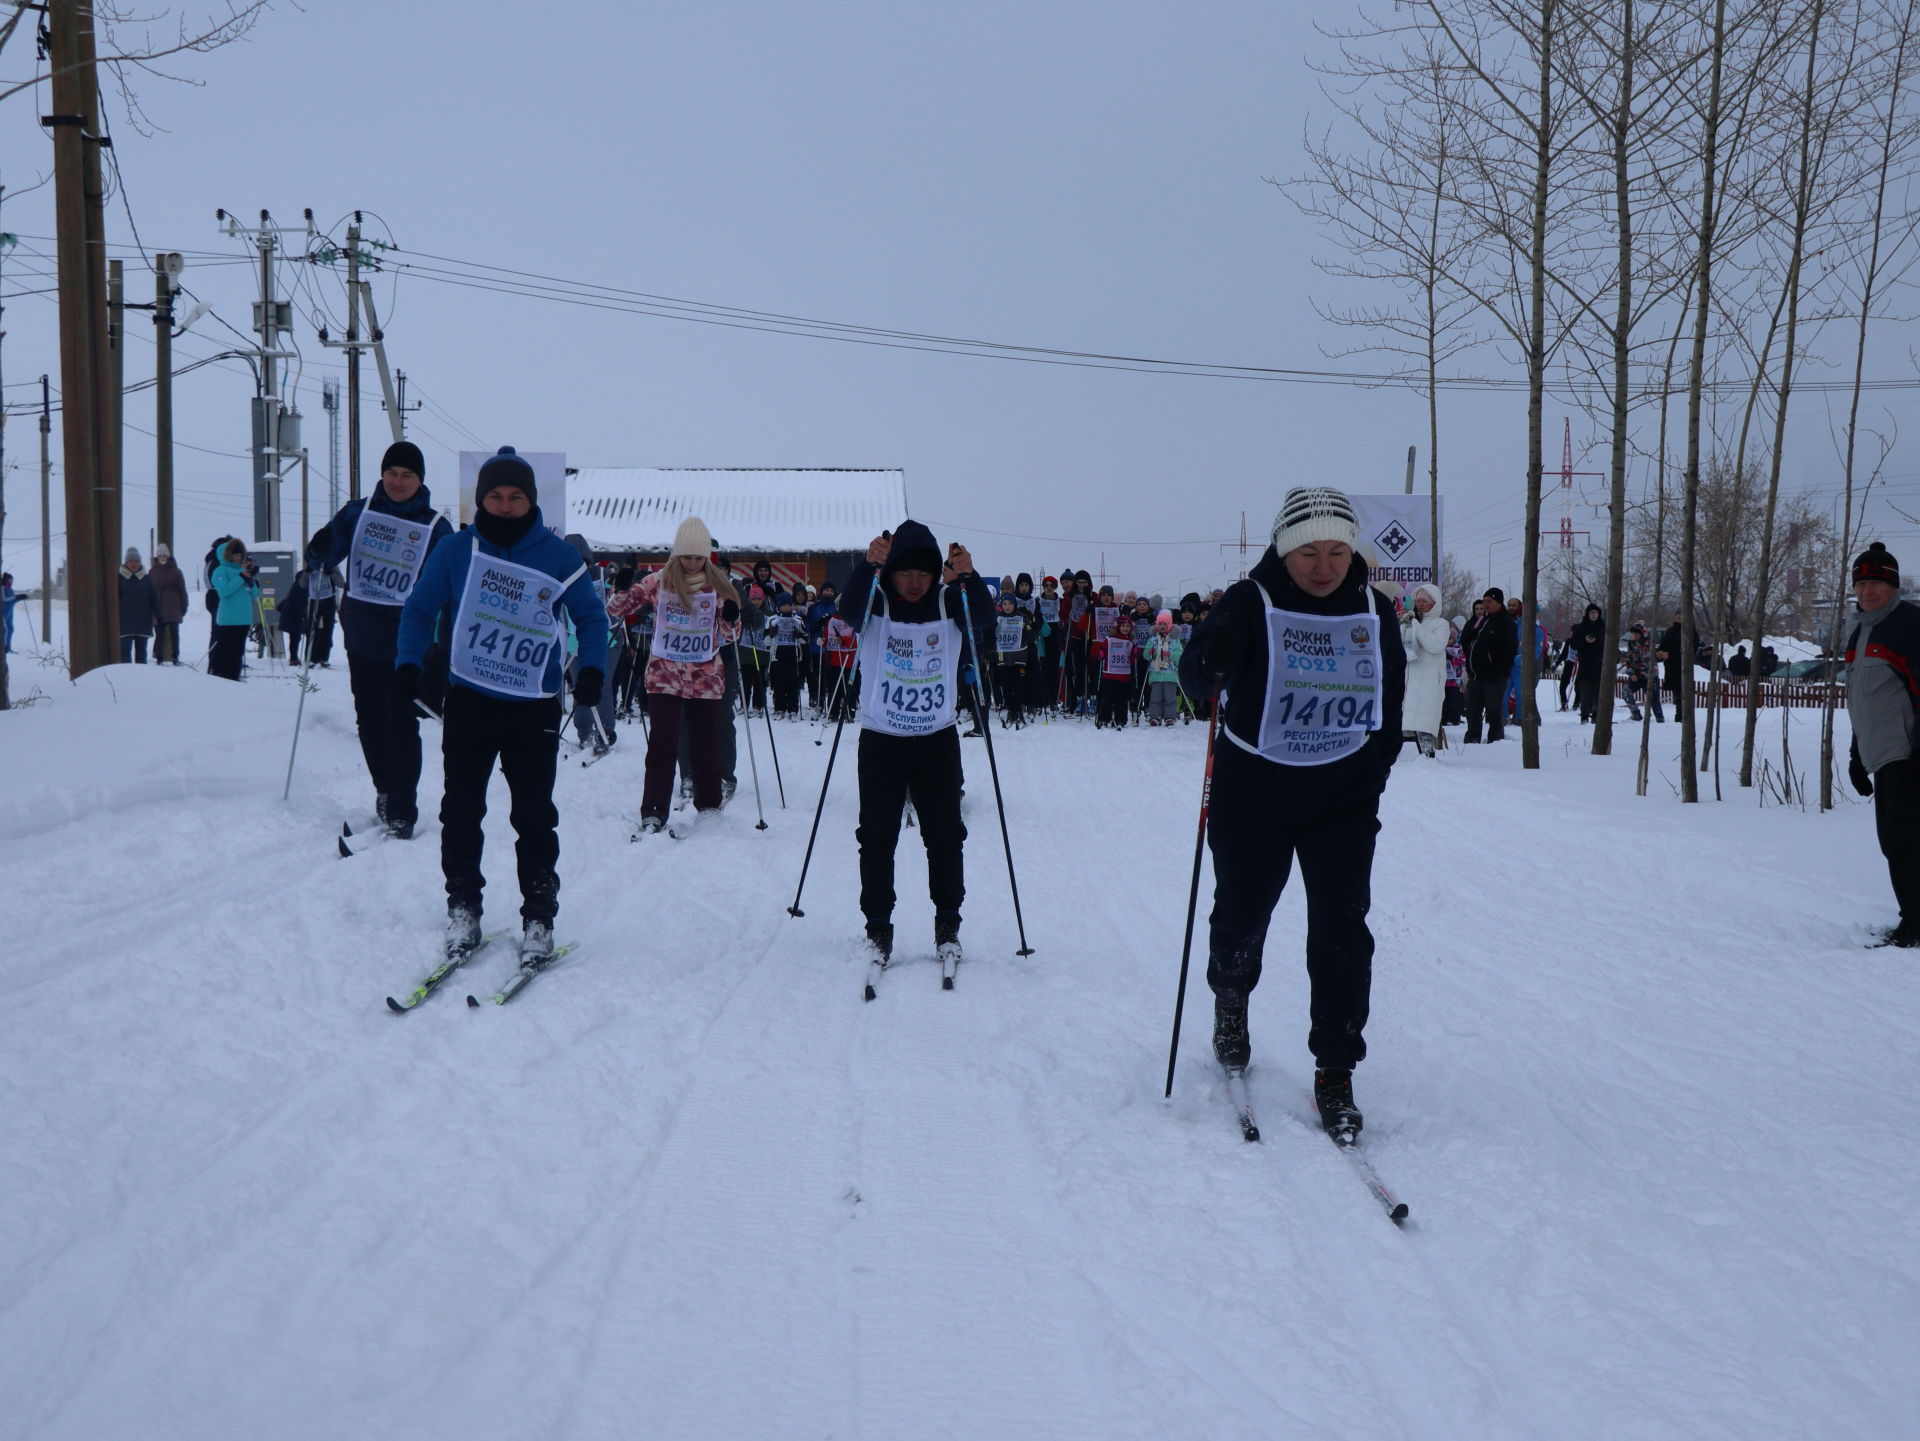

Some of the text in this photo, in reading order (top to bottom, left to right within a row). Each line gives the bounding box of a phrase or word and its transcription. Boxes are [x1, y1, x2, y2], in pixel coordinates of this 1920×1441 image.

[364, 528, 396, 543] РОССИИ
[366, 521, 398, 535] ЛЫЖНЯ
[362, 536, 393, 553] 2022
[355, 559, 411, 593] 14400
[482, 568, 526, 591] ЛЫЖНЯ
[480, 578, 524, 602] РОССИИ
[477, 591, 519, 616] 2022
[665, 613, 690, 625] 2022
[468, 622, 549, 668] 14160
[662, 632, 711, 653] 14200
[888, 635, 913, 649] ЖНЯ
[1282, 627, 1332, 646] ЛЫЖНЯ
[1284, 639, 1335, 657] РОССИИ
[471, 655, 529, 678] РЕСПУБЛИКА
[1286, 654, 1338, 673] 2022
[474, 667, 526, 688] ТАТАРСТАН
[1284, 680, 1312, 690] СПОРТ
[1318, 683, 1350, 692] НОРМА
[881, 680, 945, 713] 14233
[886, 709, 936, 723] РЕСПУБЛИКА
[1279, 692, 1376, 737] 14194
[888, 719, 934, 732] ТАТАРСТАН
[1283, 730, 1349, 741] РЕСПУБ
[1288, 736, 1350, 754] ТАТАРСТАН
